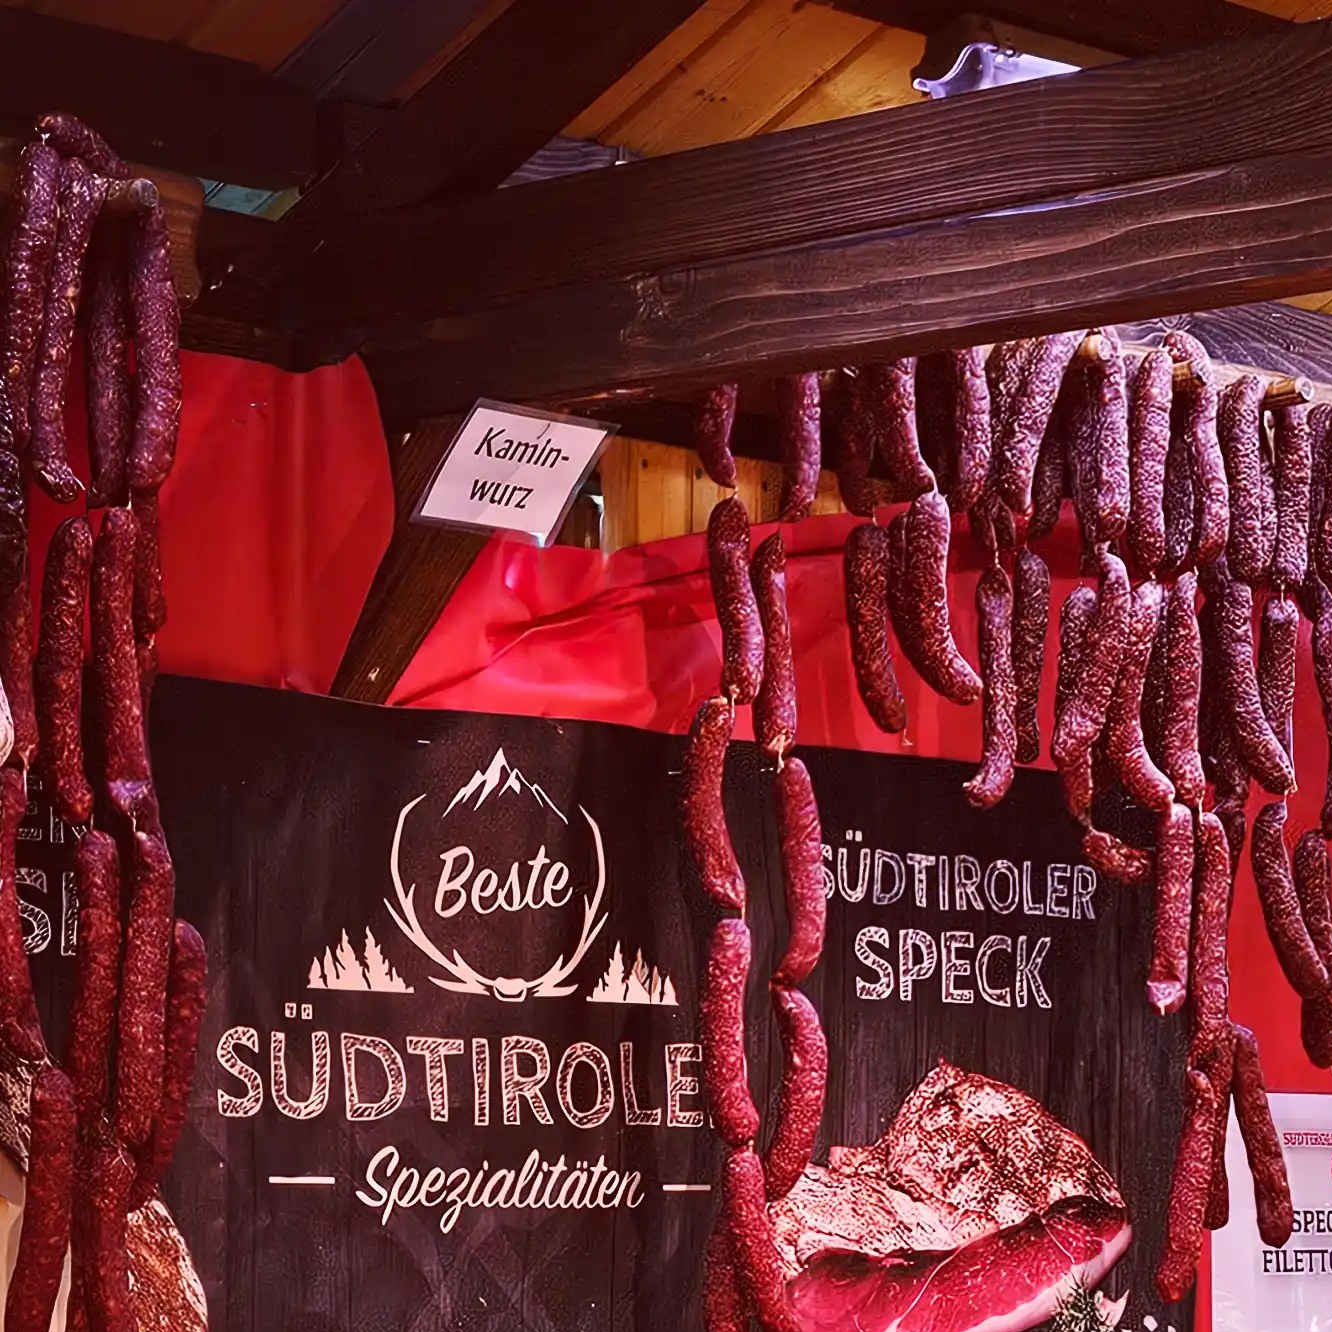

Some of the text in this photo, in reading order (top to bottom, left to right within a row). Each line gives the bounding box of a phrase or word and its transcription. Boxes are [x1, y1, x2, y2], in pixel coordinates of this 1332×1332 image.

[474, 426, 570, 470] Kamin-
[469, 478, 534, 510] wurz
[434, 845, 574, 918] Beste
[854, 925, 1053, 1009] SPECK
[216, 1002, 716, 1130] SÜDTIROLE
[355, 1145, 645, 1234] Spezialitäten
